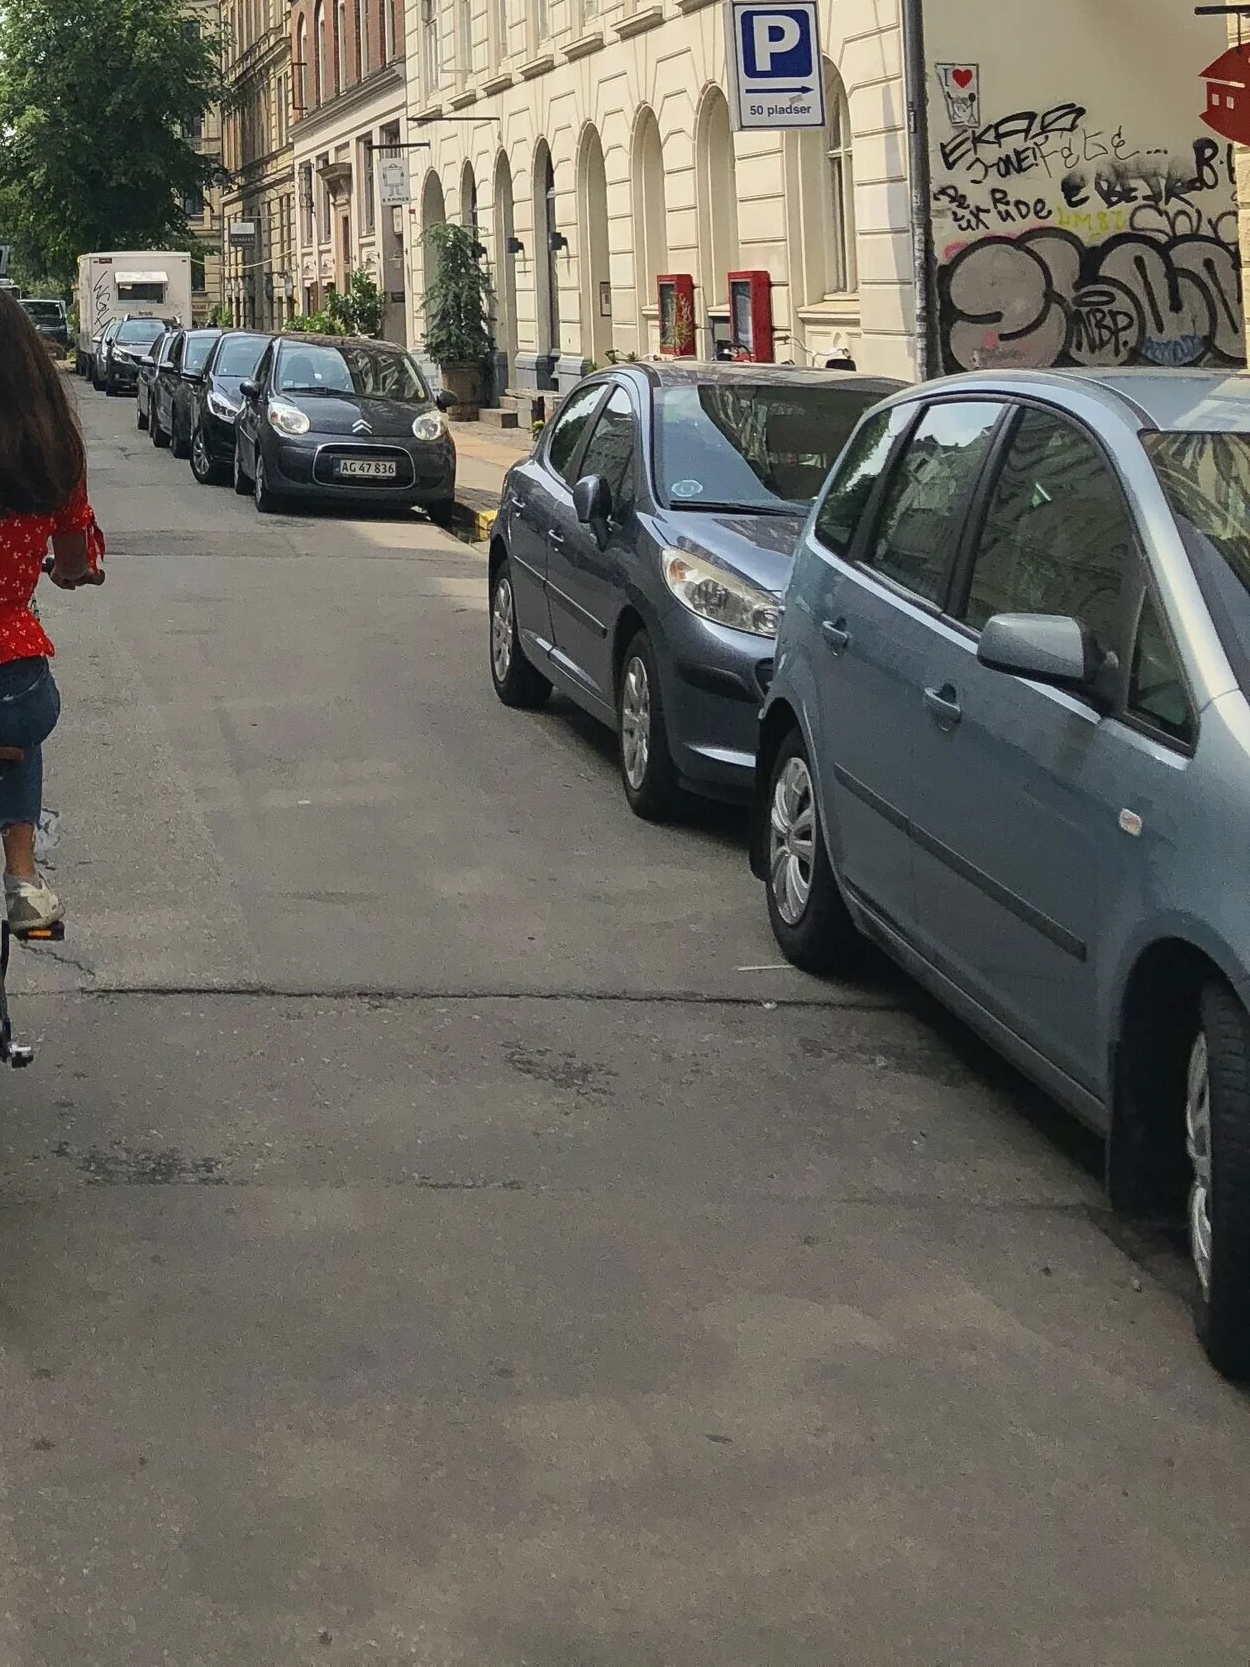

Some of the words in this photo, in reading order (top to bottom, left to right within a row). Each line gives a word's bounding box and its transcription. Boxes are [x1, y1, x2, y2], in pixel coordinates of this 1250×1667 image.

[753, 15, 800, 71] P
[750, 105, 764, 115] 50
[767, 104, 812, 117] pladser
[341, 462, 356, 473] AG
[358, 462, 371, 473] 47
[374, 463, 395, 474] 836
